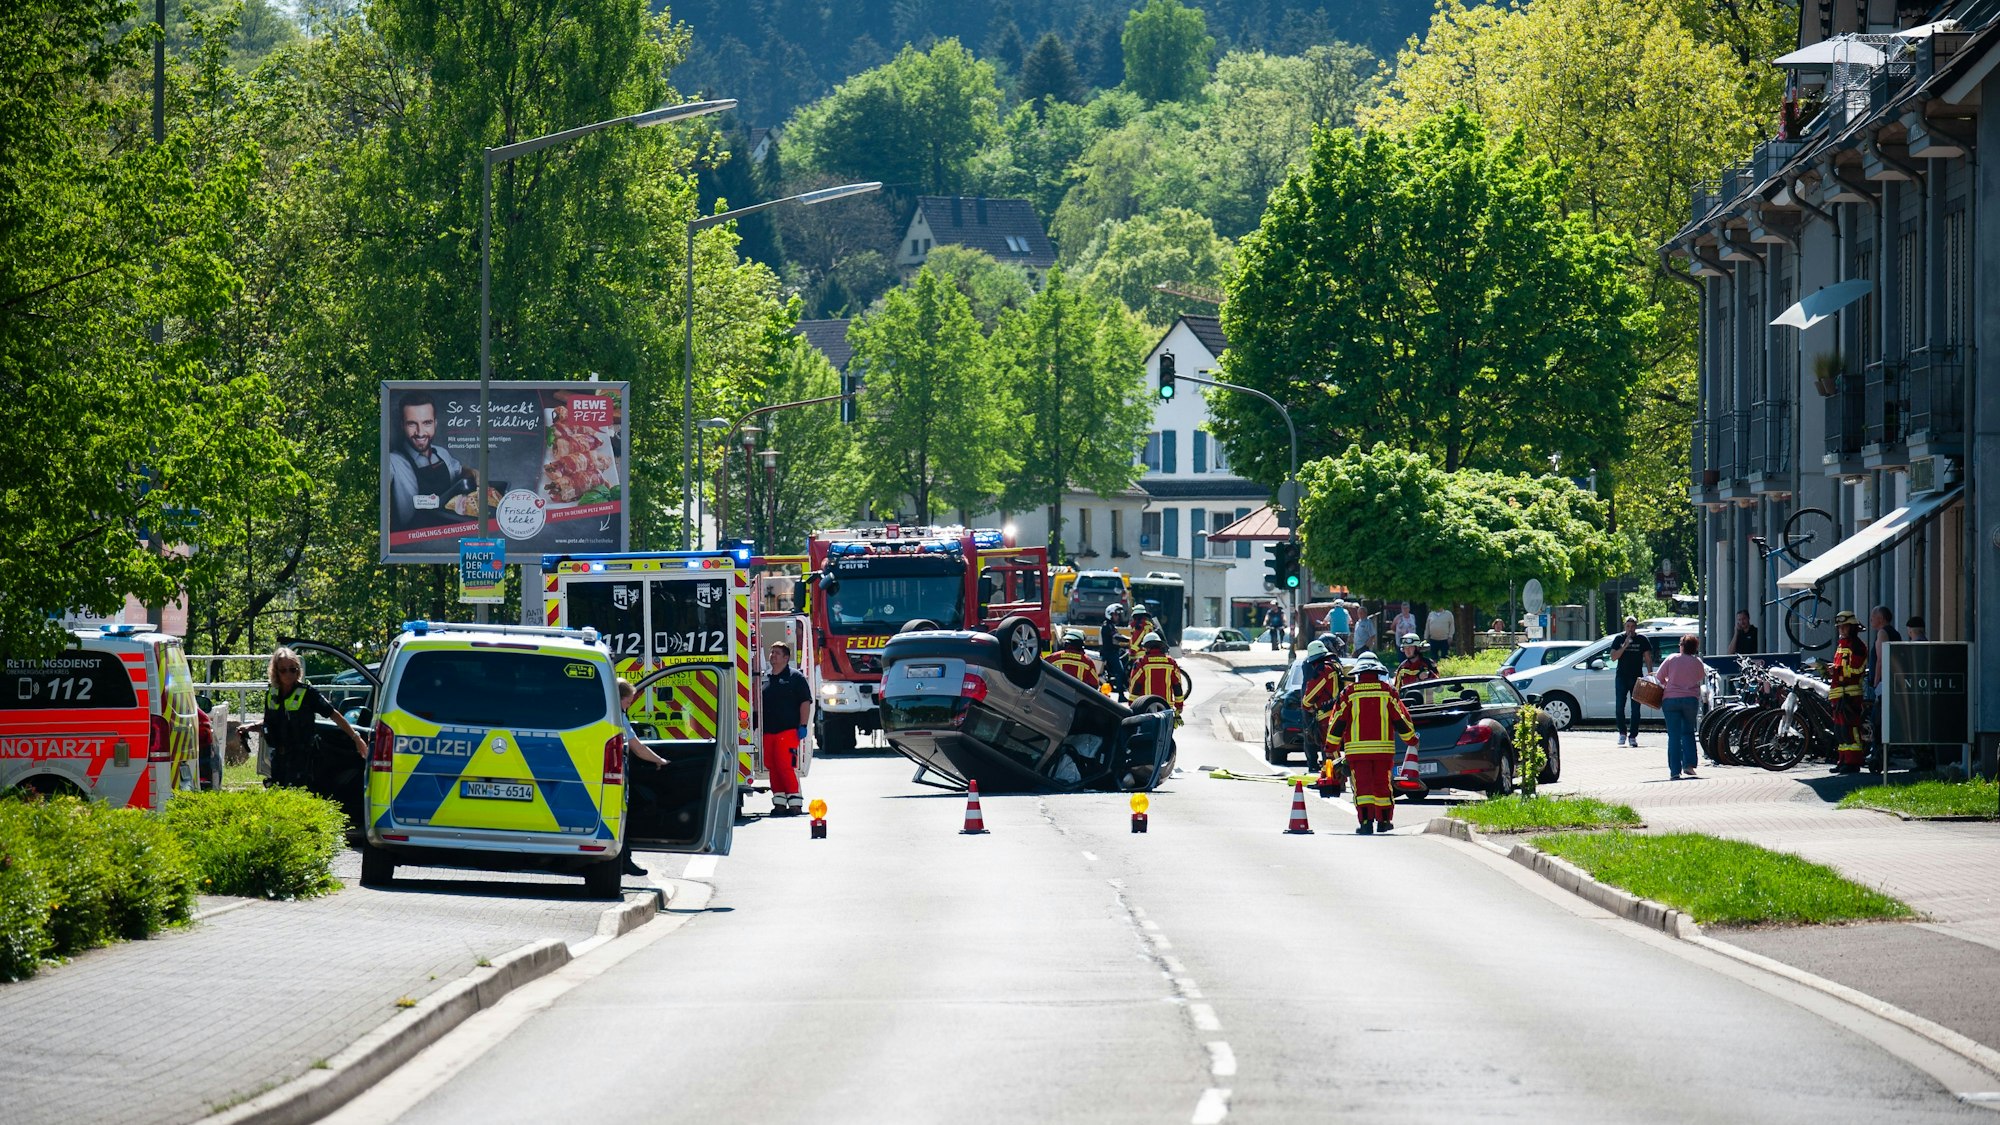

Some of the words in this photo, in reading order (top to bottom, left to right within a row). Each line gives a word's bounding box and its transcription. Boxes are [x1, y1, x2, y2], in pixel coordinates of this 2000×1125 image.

[447, 401, 463, 413] So
[573, 400, 607, 410] REWE
[447, 416, 471, 427] der
[574, 411, 607, 421] PETZ
[599, 504, 614, 512] MARKT
[508, 515, 535, 523] theke
[465, 552, 495, 560] NACHT
[466, 561, 482, 569] DER
[466, 571, 503, 579] TECHNIK
[686, 631, 725, 653] 112
[846, 636, 891, 649] FEUE
[47, 677, 93, 700] 112
[1904, 678, 1956, 689] NOHL
[0, 739, 105, 757] NOTARZT
[395, 736, 472, 757] POLIZEI
[467, 783, 489, 798] NRW
[493, 784, 532, 799] 5-6514
